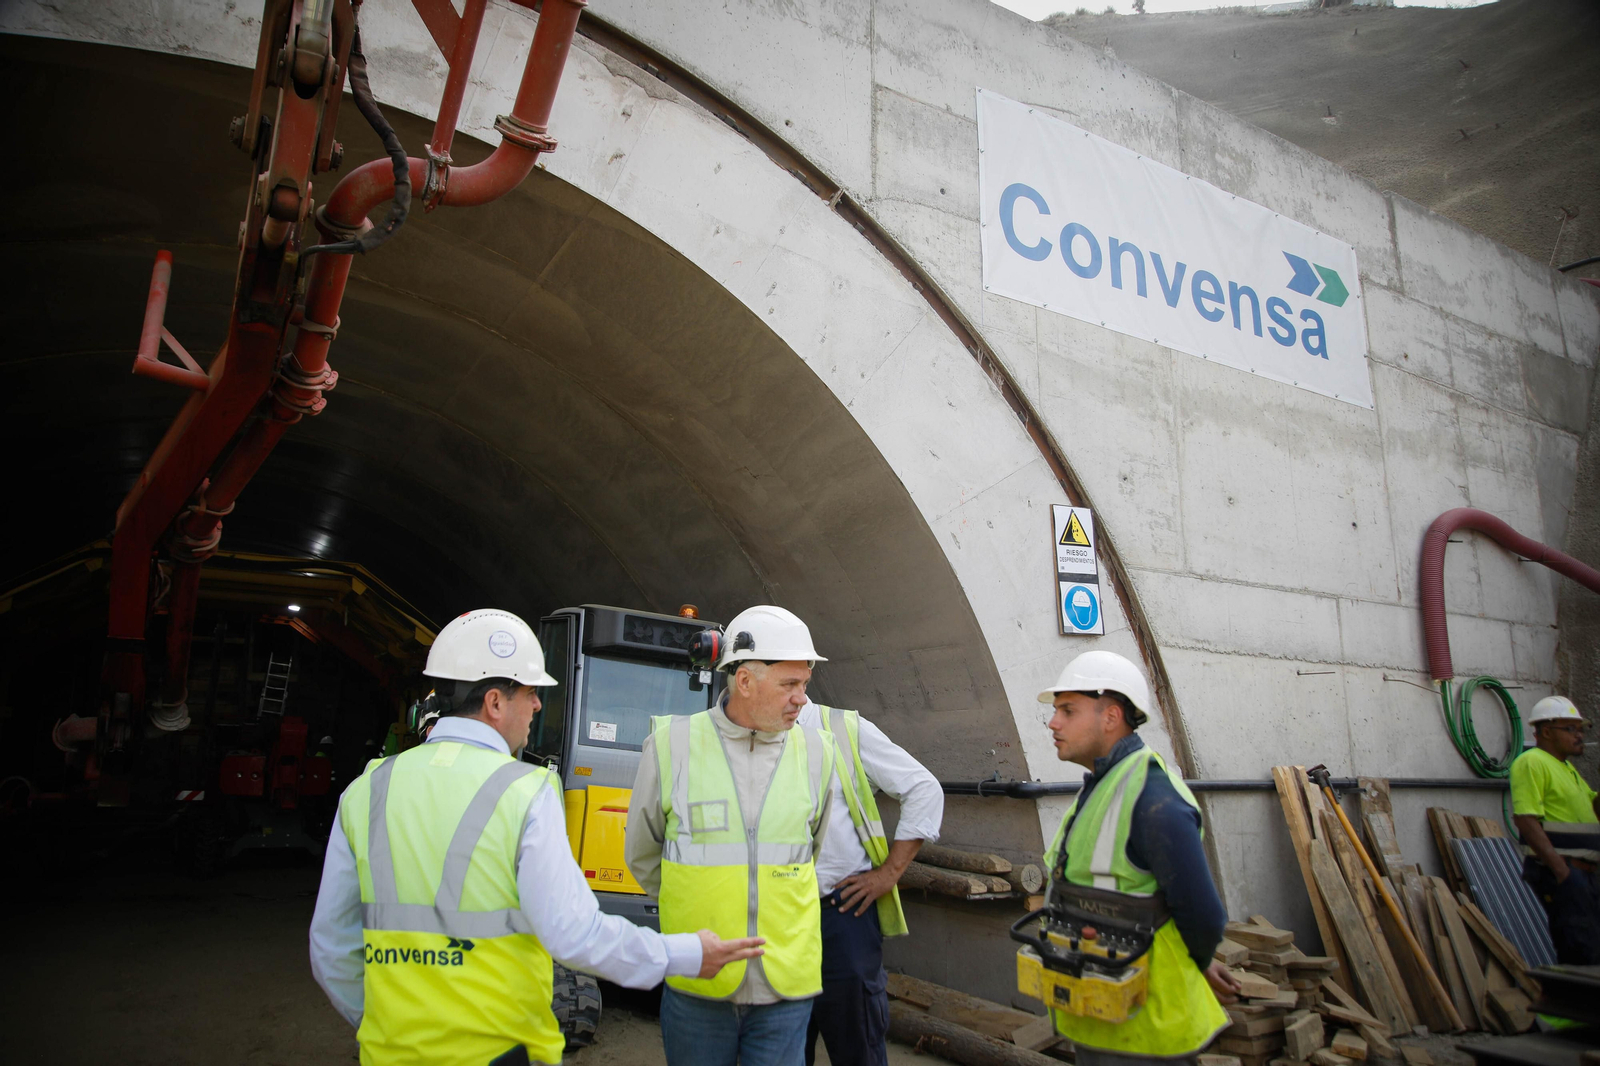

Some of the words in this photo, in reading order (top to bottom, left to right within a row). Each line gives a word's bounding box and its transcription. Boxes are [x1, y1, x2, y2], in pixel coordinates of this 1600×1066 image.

[999, 182, 1330, 360] Convensa
[1079, 899, 1118, 916] IMET
[364, 943, 463, 965] Convensa
